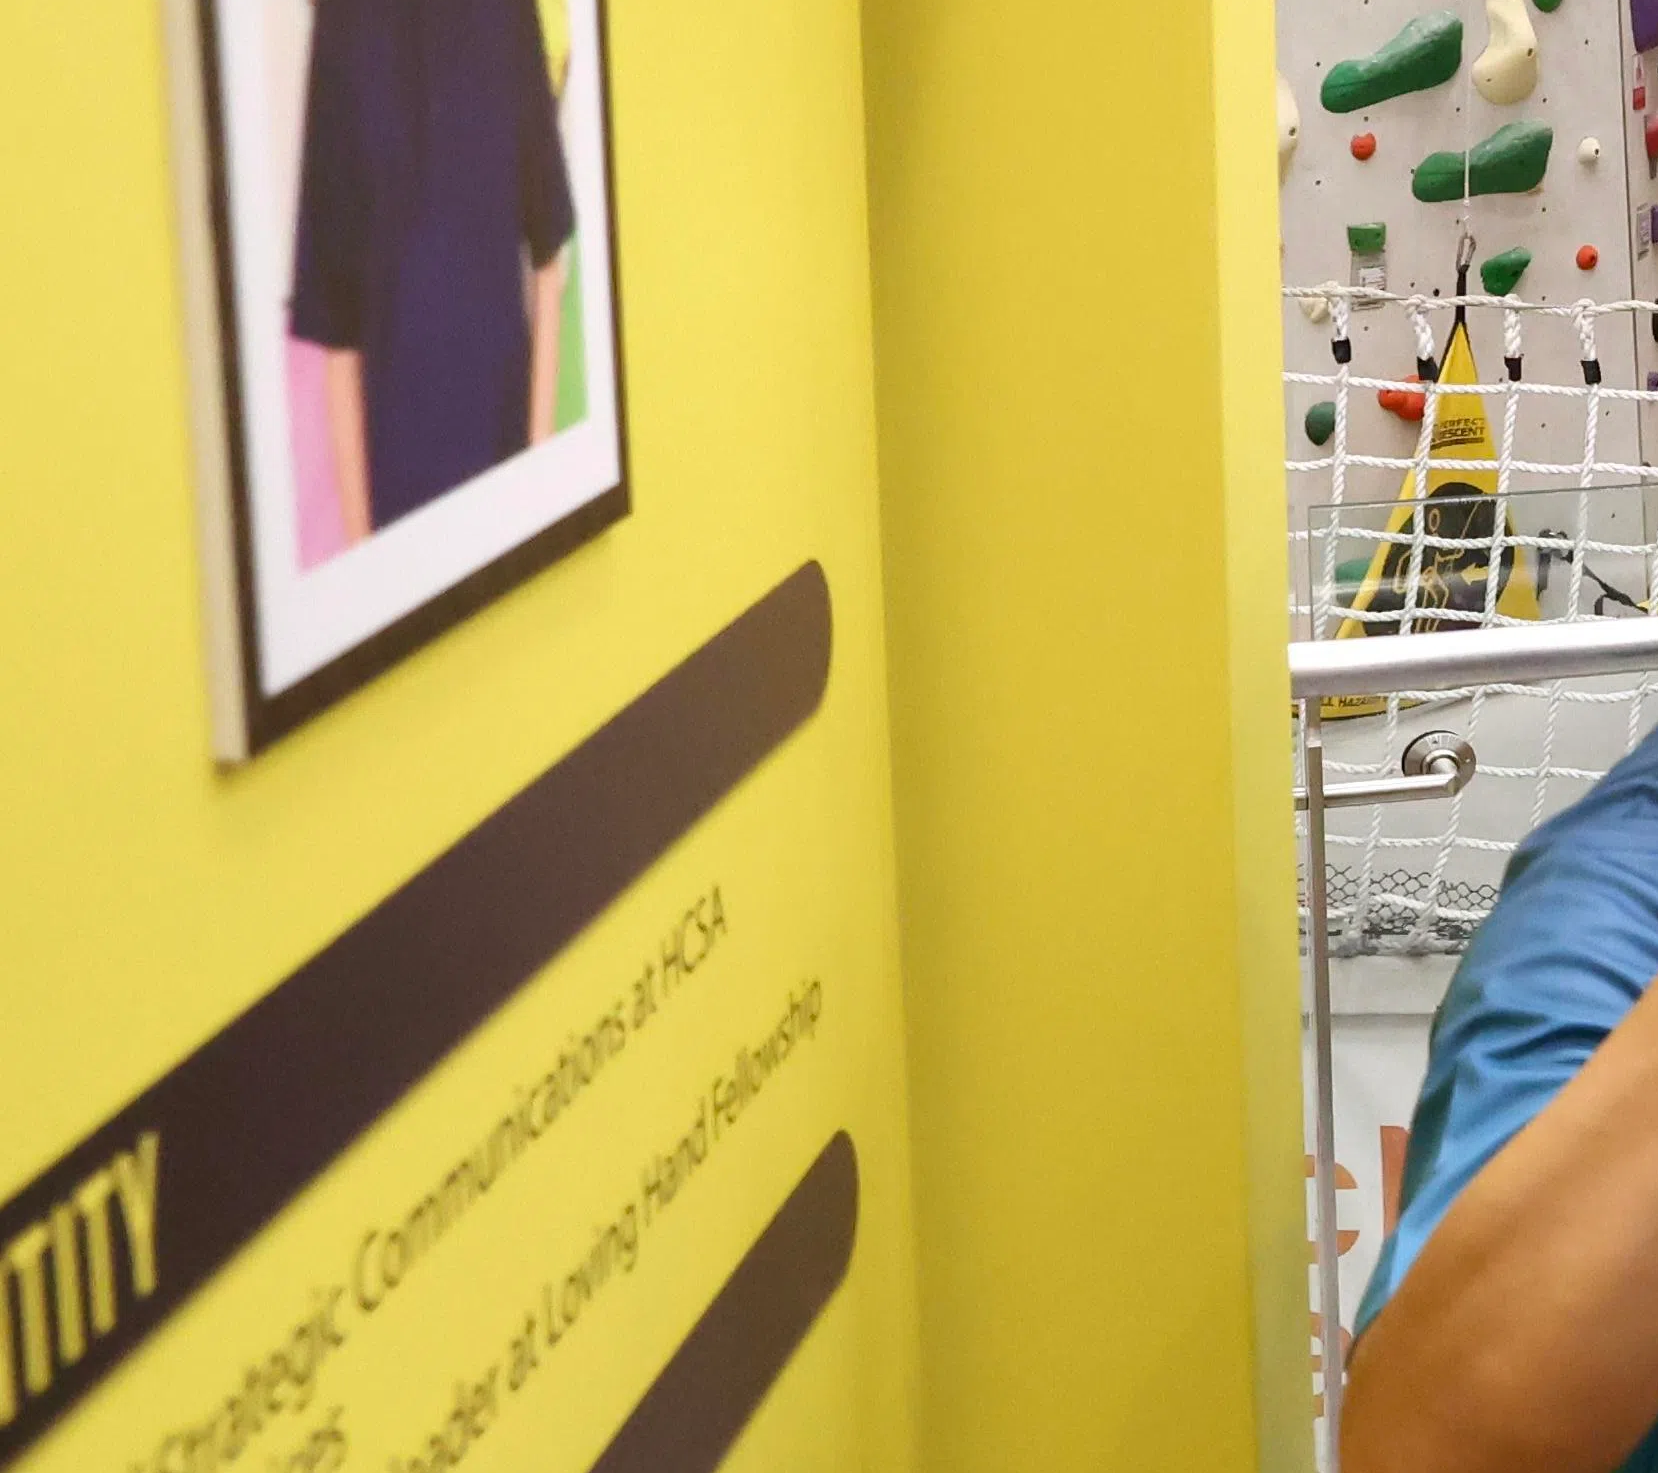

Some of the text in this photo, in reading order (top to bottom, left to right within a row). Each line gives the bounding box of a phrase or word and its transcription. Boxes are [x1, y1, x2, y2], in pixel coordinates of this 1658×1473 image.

[354, 997, 627, 1314] Communications
[632, 963, 658, 1031] at
[660, 884, 729, 996] HCSA
[506, 1306, 541, 1396] at
[541, 1202, 640, 1347] Loving
[641, 1094, 709, 1226] Hand
[711, 978, 823, 1140] Fellowship
